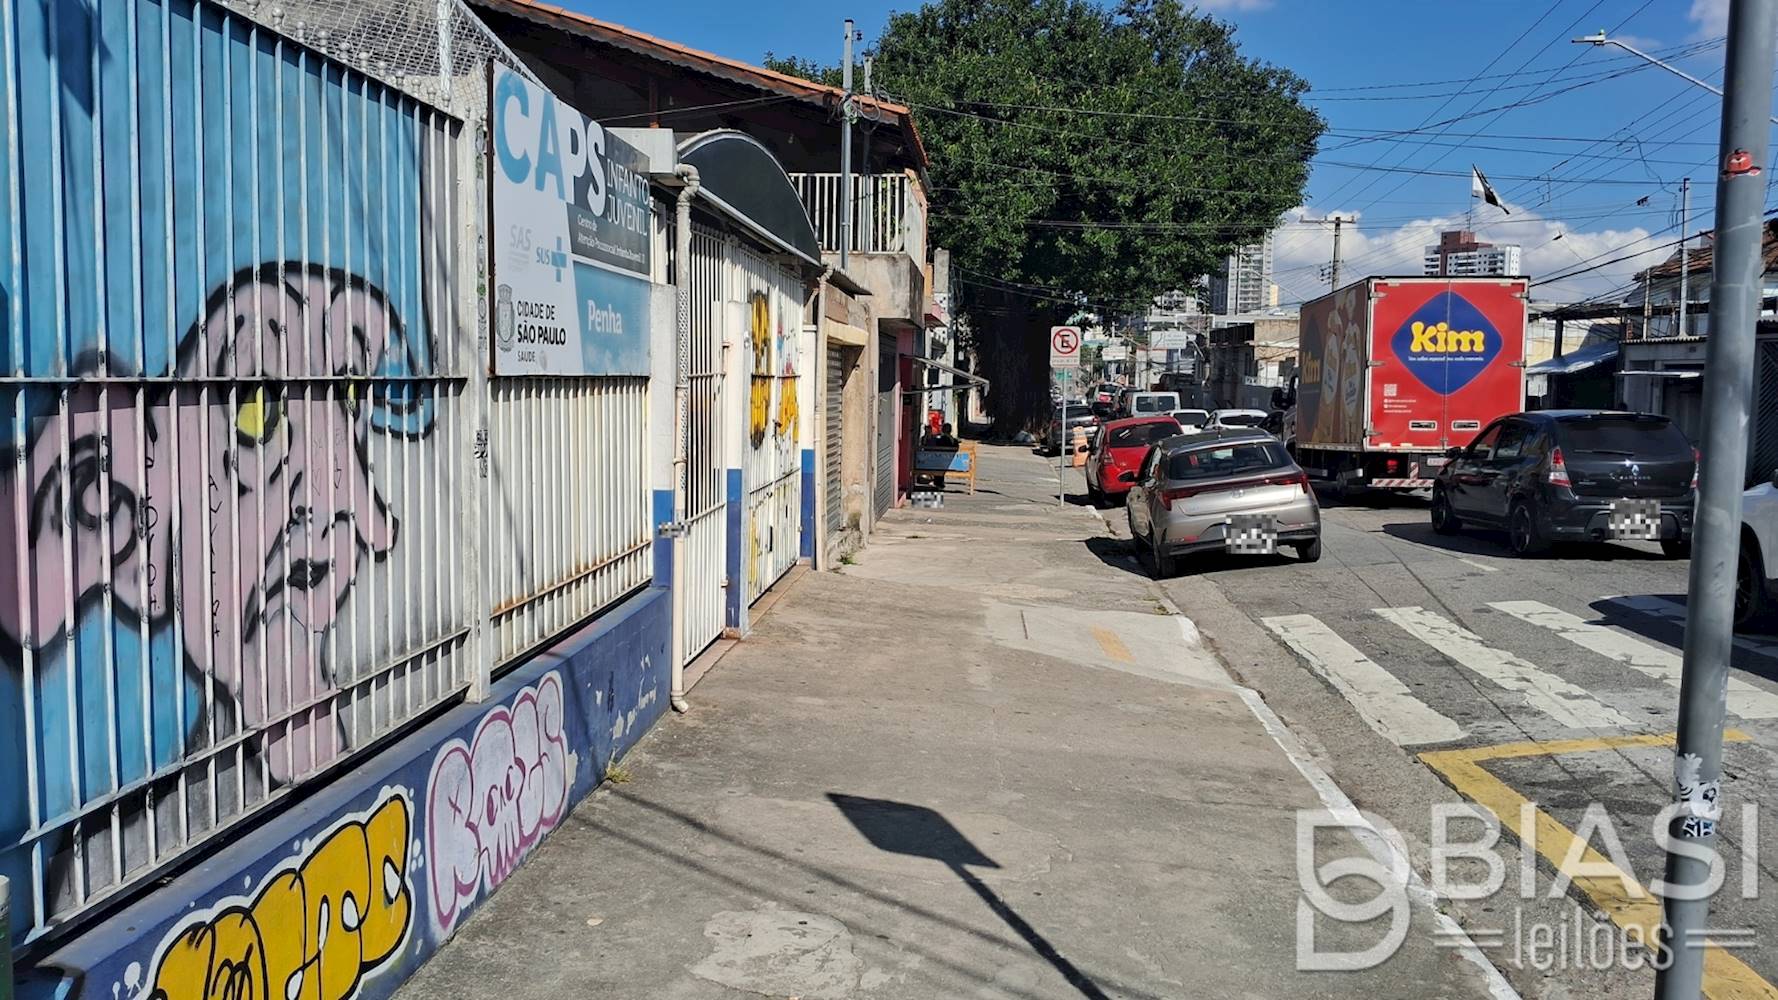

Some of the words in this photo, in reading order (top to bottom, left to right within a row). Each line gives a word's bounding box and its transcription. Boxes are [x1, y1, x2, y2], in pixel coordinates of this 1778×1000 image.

[495, 72, 606, 217] CAPS
[607, 158, 649, 205] INFANTO
[607, 194, 648, 236] JUVENIL
[536, 246, 550, 265] SUS
[517, 300, 544, 319] CIDADE
[545, 304, 556, 320] DE
[587, 299, 623, 335] Penha
[517, 319, 536, 344] SÃO
[537, 325, 566, 345] PAULO
[1410, 321, 1485, 353] Kim
